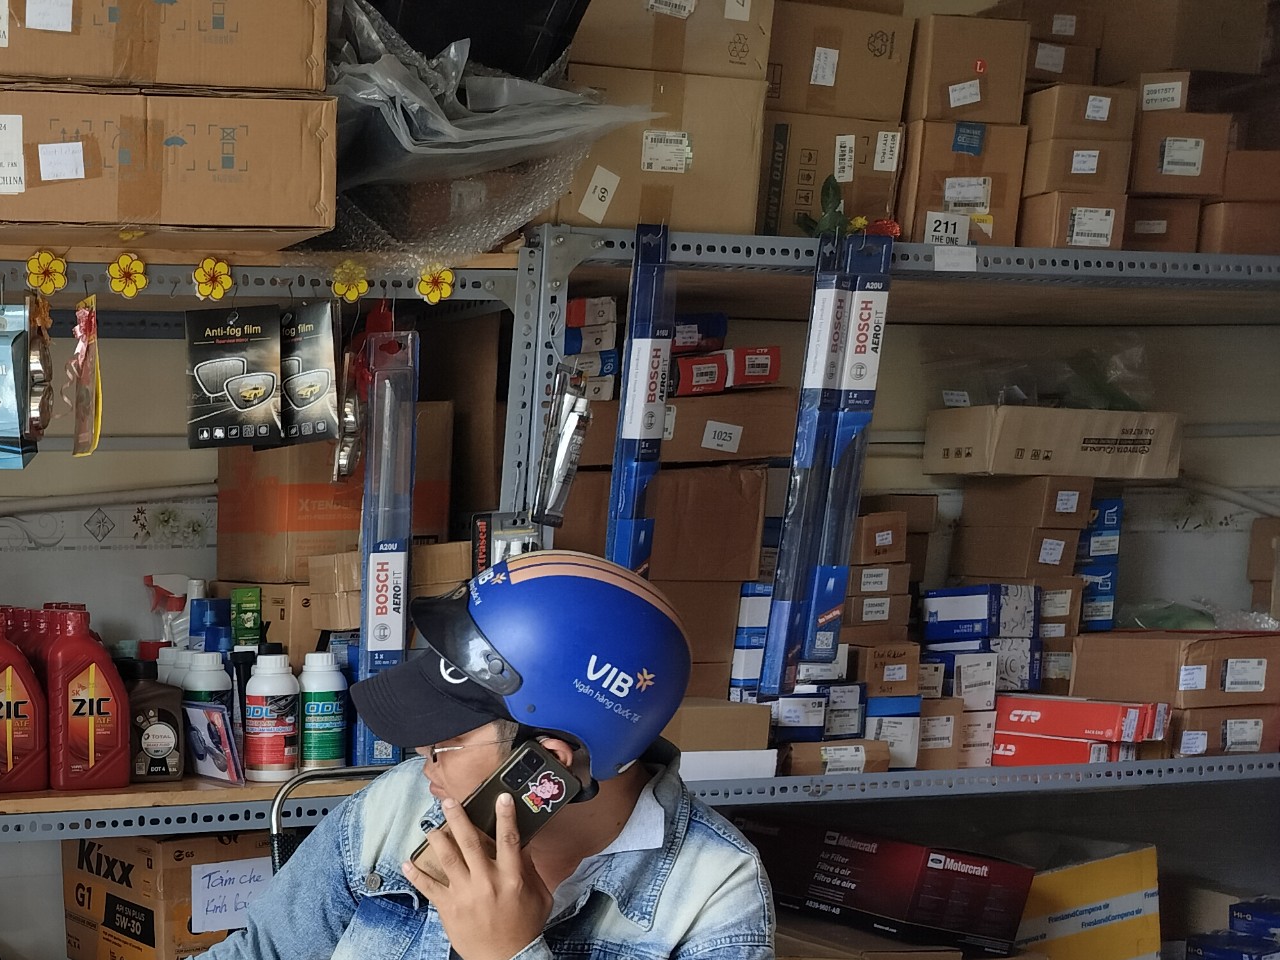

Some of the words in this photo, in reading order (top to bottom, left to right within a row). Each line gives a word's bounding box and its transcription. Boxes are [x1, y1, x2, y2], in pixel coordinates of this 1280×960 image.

[932, 218, 958, 235] 211
[930, 234, 944, 244] THE
[864, 281, 883, 291] A20U
[204, 326, 242, 338] Anti-fog
[243, 324, 262, 335] film
[297, 323, 314, 334] film
[830, 298, 844, 354] BOSCH
[854, 299, 874, 355] BOSCH
[870, 310, 884, 354] AEROFIT
[647, 347, 662, 403] BOSCH
[712, 430, 733, 442] 1025
[378, 543, 398, 551] A20U
[375, 561, 390, 616] BOSCH
[392, 570, 402, 615] AEROFIT
[586, 654, 634, 698] VIB
[71, 697, 112, 717] ZIC
[305, 701, 344, 715] ODL
[1009, 709, 1042, 724] CTR
[185, 850, 195, 858] GS
[837, 836, 878, 853] Motorcraft
[77, 838, 135, 889] Kixx
[819, 850, 830, 859] Air
[830, 853, 850, 864] Filter
[944, 857, 989, 877] Motorcraft
[813, 872, 831, 883] Filtro
[831, 877, 841, 886] de
[841, 880, 857, 890] aire
[75, 882, 92, 910] G1
[114, 913, 142, 936] 5W-30
[1081, 909, 1135, 929] FrieslandCampina
